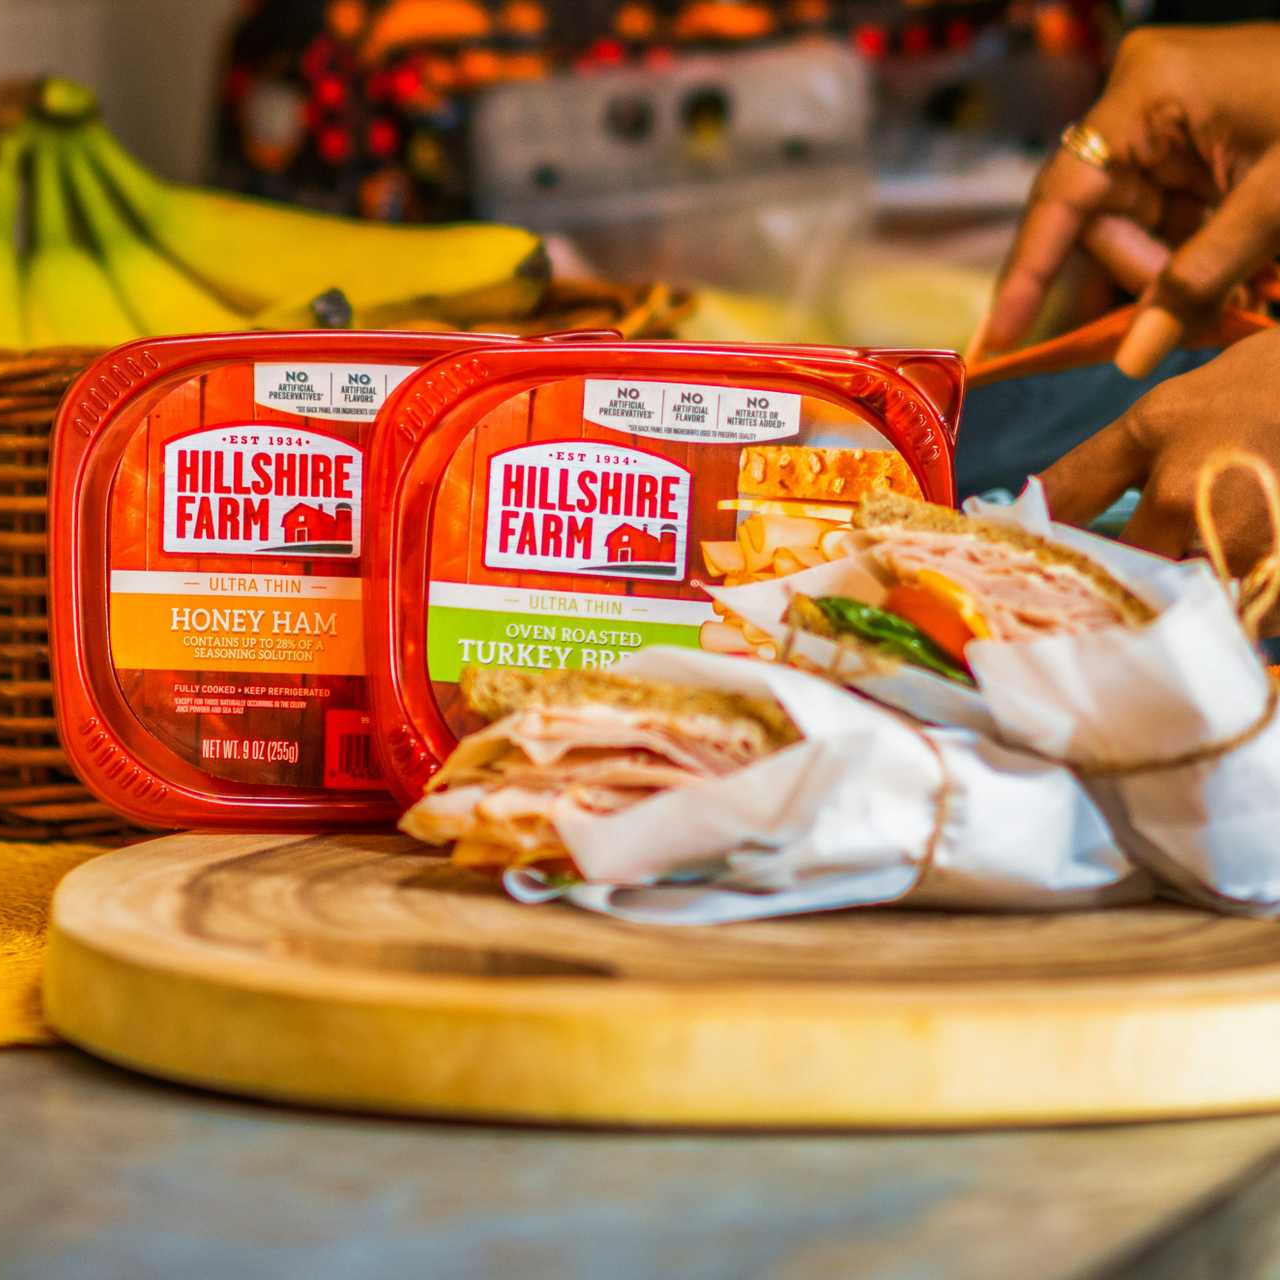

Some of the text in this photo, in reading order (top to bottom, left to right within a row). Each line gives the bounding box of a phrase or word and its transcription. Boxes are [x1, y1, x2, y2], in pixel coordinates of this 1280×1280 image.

[286, 371, 308, 383] NO
[348, 374, 371, 385] NO
[278, 383, 314, 392] ARTIFICIAL
[341, 386, 376, 395] ARTIFICIAL
[617, 387, 640, 400] NO
[344, 394, 374, 403] FLAVORS
[609, 399, 645, 410] ARTIFICIAL
[680, 392, 704, 404] NO
[746, 397, 770, 410] NO
[672, 405, 709, 415] ARTIFICIAL
[735, 409, 779, 419] NITRATES OR
[675, 413, 705, 423] FLAVORS
[727, 416, 757, 426] NITRITES
[229, 435, 303, 446] EST 1934
[556, 451, 630, 465] EST 1934
[177, 449, 354, 499] HILLSHIRE
[502, 463, 681, 520] HILLSHIRE
[176, 495, 270, 541] FARM
[499, 509, 594, 560] FARM
[209, 576, 302, 593] ULTRA THIN
[529, 594, 623, 615] ULTRA THIN
[170, 607, 339, 637] HONEY HAM
[505, 623, 643, 648] OVEN ROASTED
[183, 635, 325, 651] CONTAINS UP TO 28% OF A
[194, 648, 314, 662] SEASONING SOLUTION
[458, 638, 573, 670] TURKEY
[174, 684, 330, 697] FULLY COOKED KEEP REFRIGERATED
[202, 738, 299, 763] NET WT. 9 OZ (255g)
